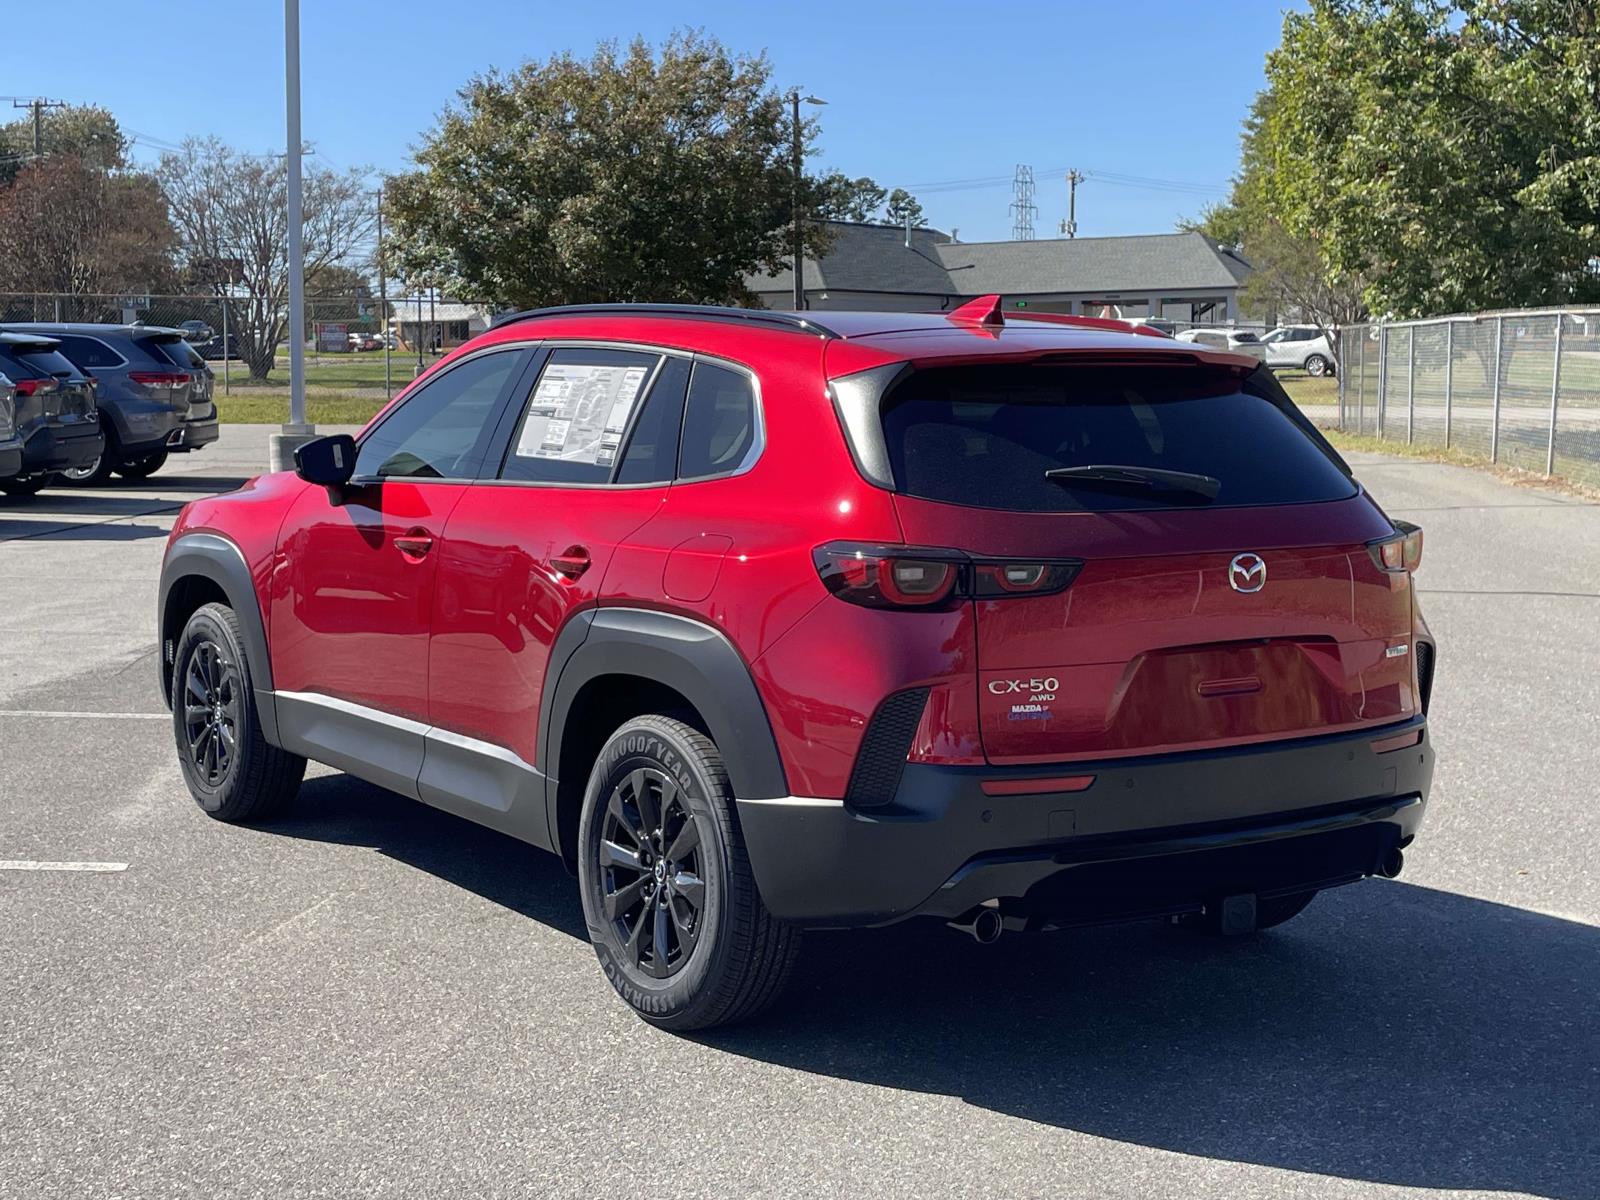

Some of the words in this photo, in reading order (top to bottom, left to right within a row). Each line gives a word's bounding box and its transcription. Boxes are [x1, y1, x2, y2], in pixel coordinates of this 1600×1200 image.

[988, 677, 1059, 694] CX-50
[1029, 694, 1055, 702] AWD
[1012, 704, 1042, 713] MAZDA
[611, 736, 692, 791] GOODYEAR
